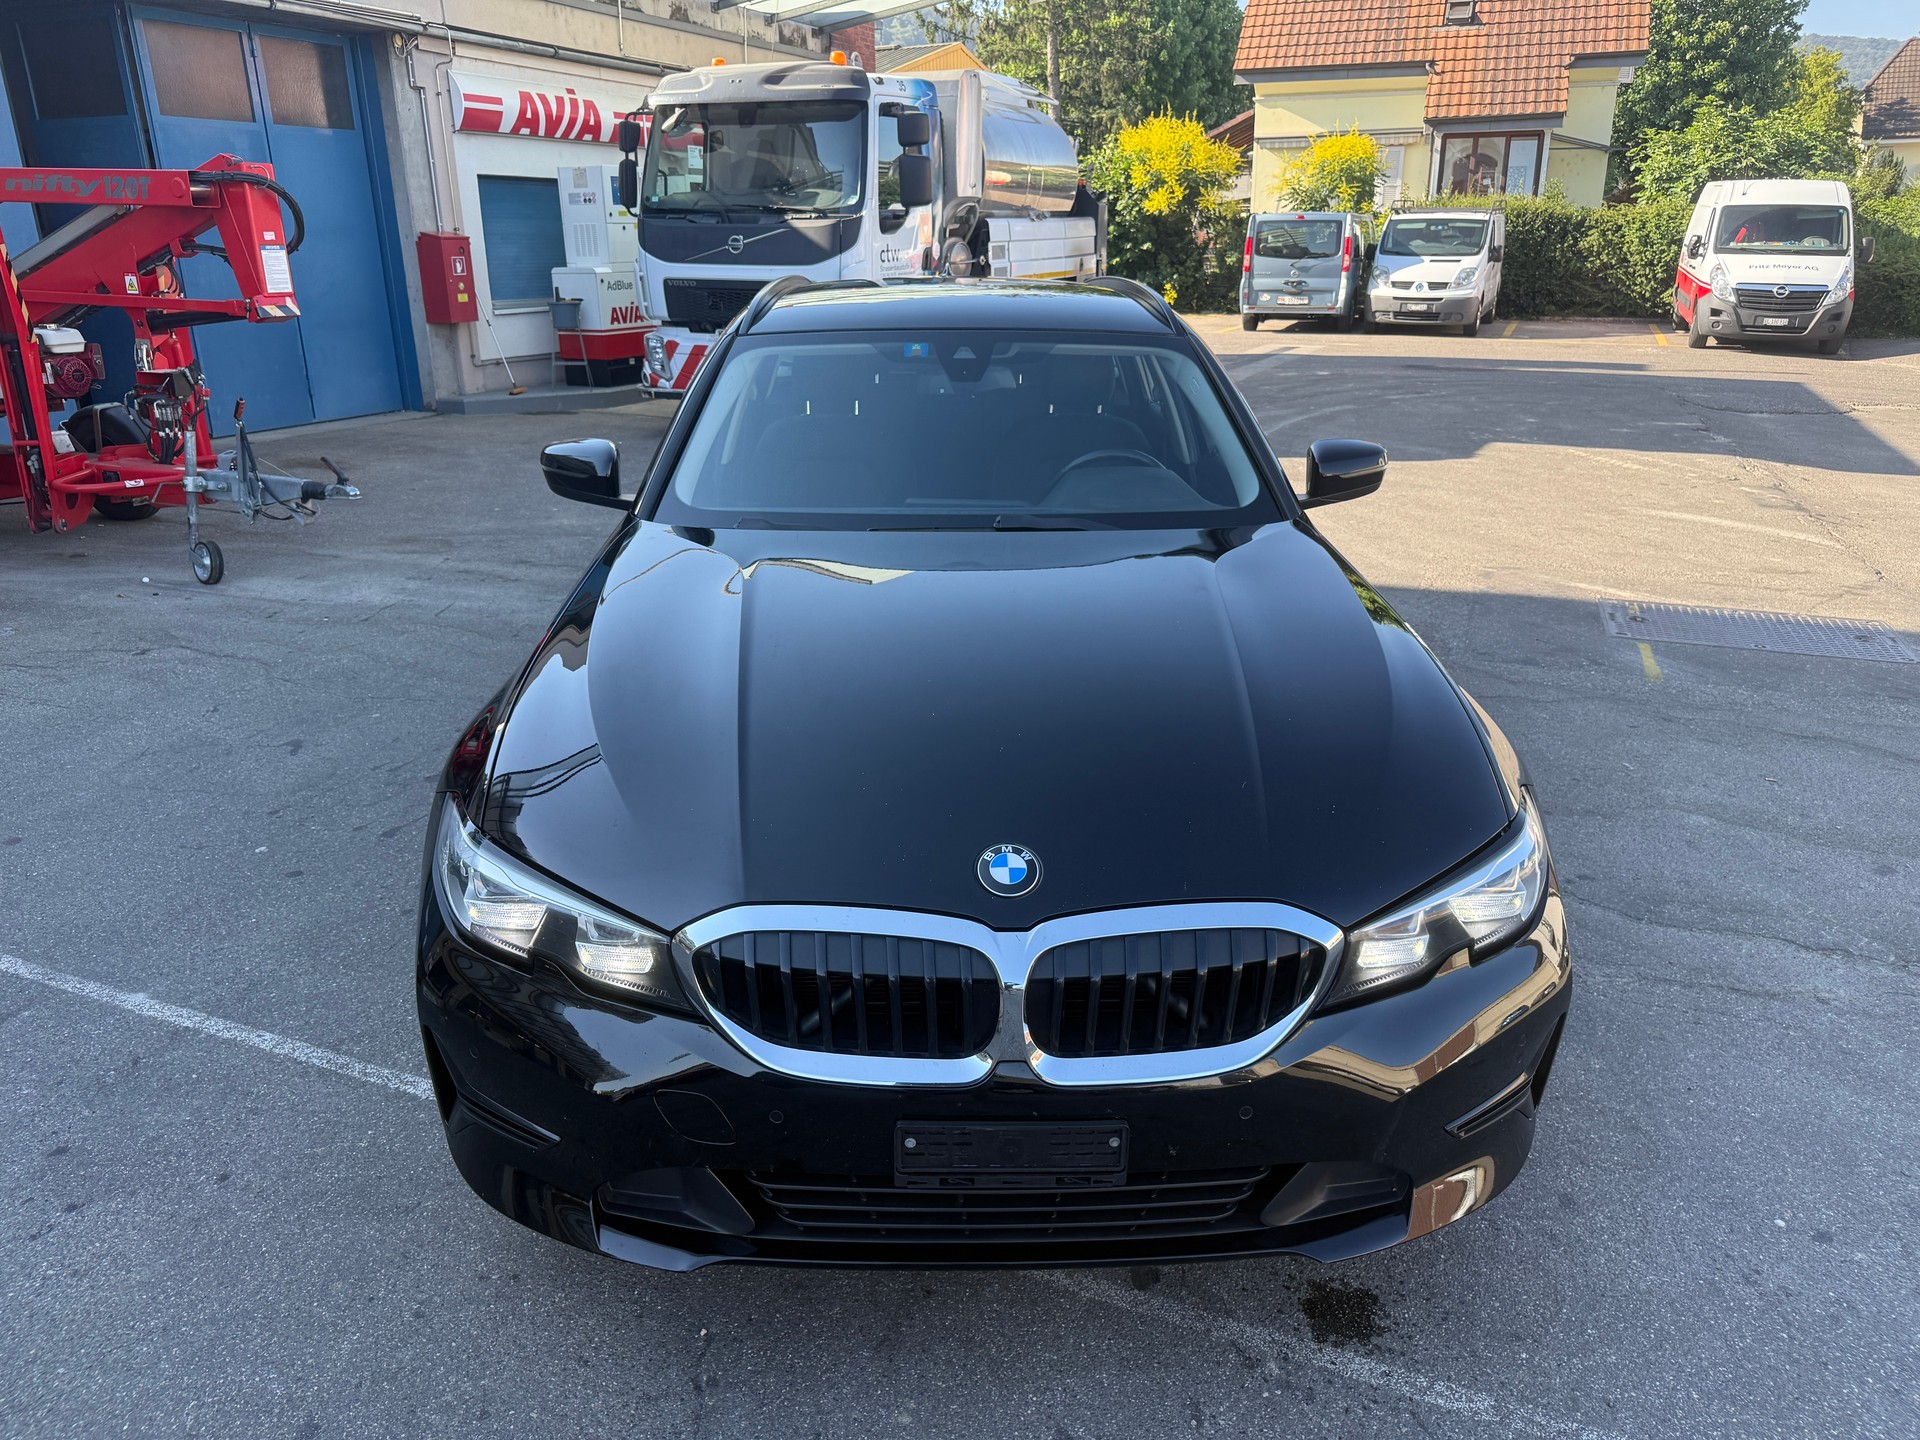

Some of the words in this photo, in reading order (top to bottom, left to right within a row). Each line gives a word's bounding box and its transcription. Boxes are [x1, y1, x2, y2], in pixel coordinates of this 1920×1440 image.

[5, 174, 101, 198] nifty
[103, 175, 151, 199] 120T
[879, 243, 901, 263] ctw
[606, 280, 634, 292] AdBlue
[666, 280, 697, 288] VOLVO
[983, 846, 1032, 861] BMW
